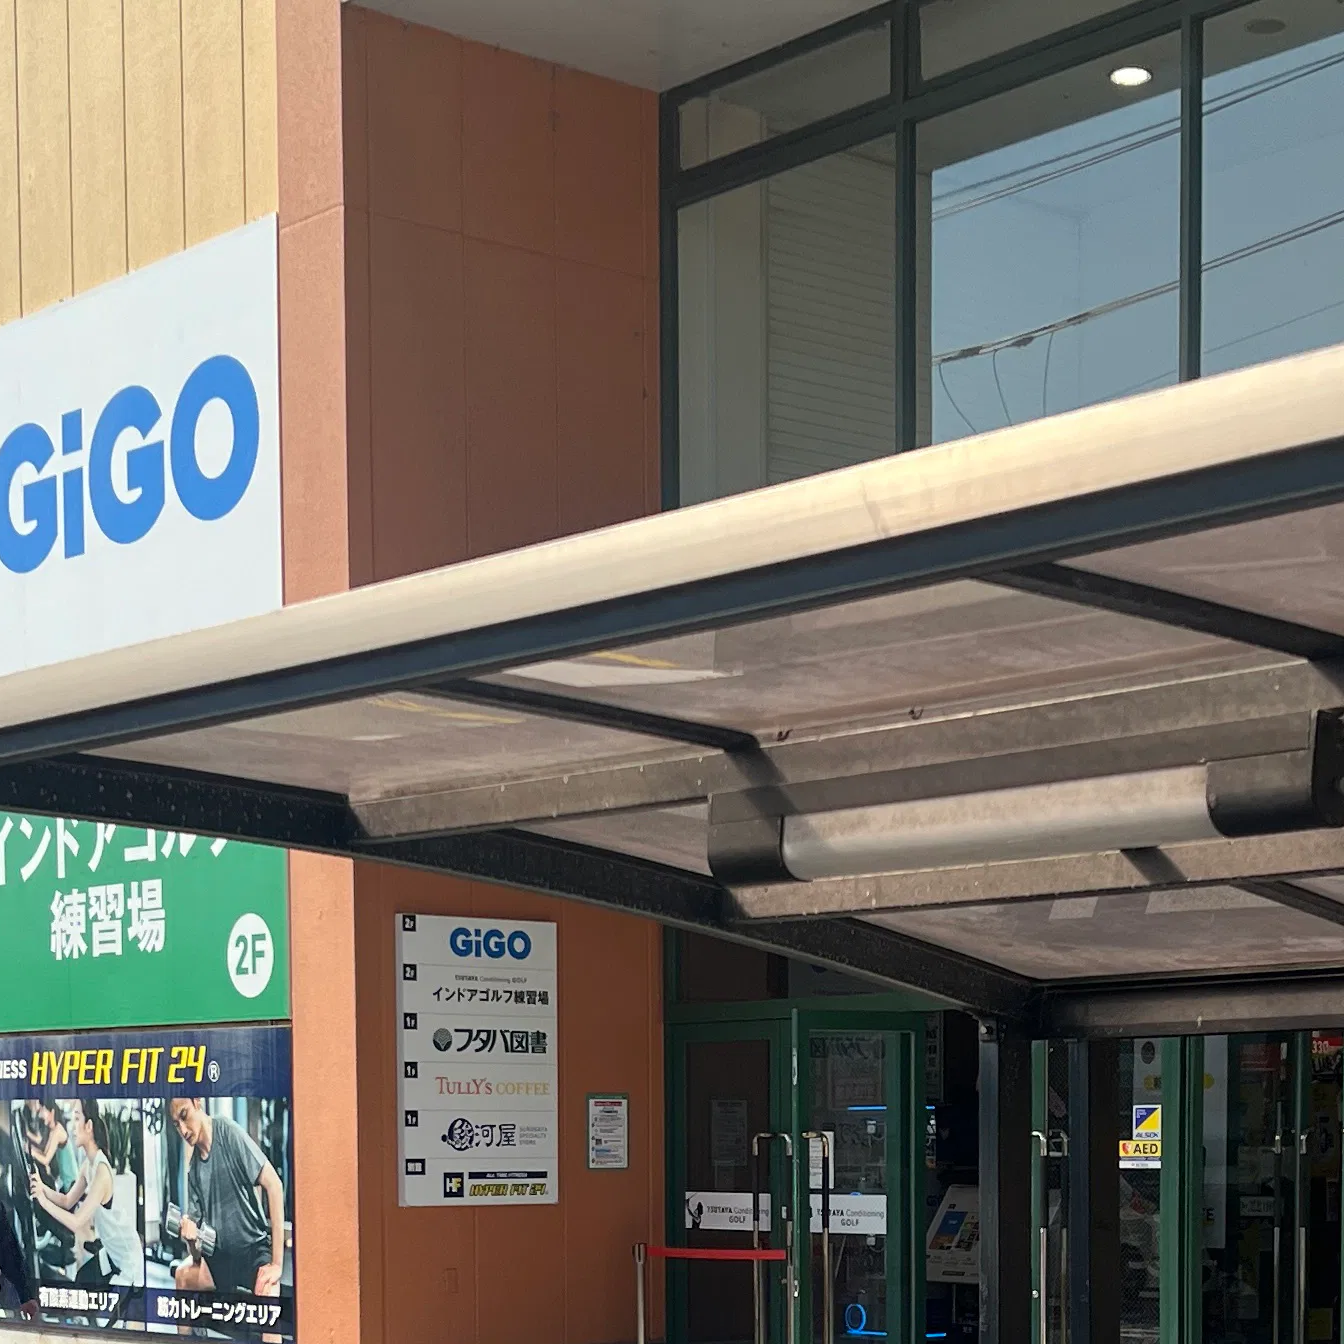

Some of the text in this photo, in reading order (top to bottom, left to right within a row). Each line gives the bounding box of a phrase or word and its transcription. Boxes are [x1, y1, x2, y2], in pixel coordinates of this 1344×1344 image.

[49, 878, 166, 961] 練習場
[450, 927, 532, 960] GiGO
[234, 933, 267, 976] 2F
[432, 986, 549, 1006] インドアゴルフ練習場
[454, 1028, 548, 1054] フタバ図書
[30, 1048, 114, 1086] HYPER
[121, 1046, 164, 1084] FIT
[167, 1045, 206, 1083] 24
[495, 1081, 551, 1096] COFFEE
[1133, 1143, 1158, 1155] AED
[707, 1205, 733, 1214] TSUTAYA
[729, 1215, 746, 1224] GOLF
[845, 1209, 885, 1220] Conditioning
[841, 1218, 859, 1227] GOLF
[157, 1296, 281, 1326] 筋力トレーニングエリア
